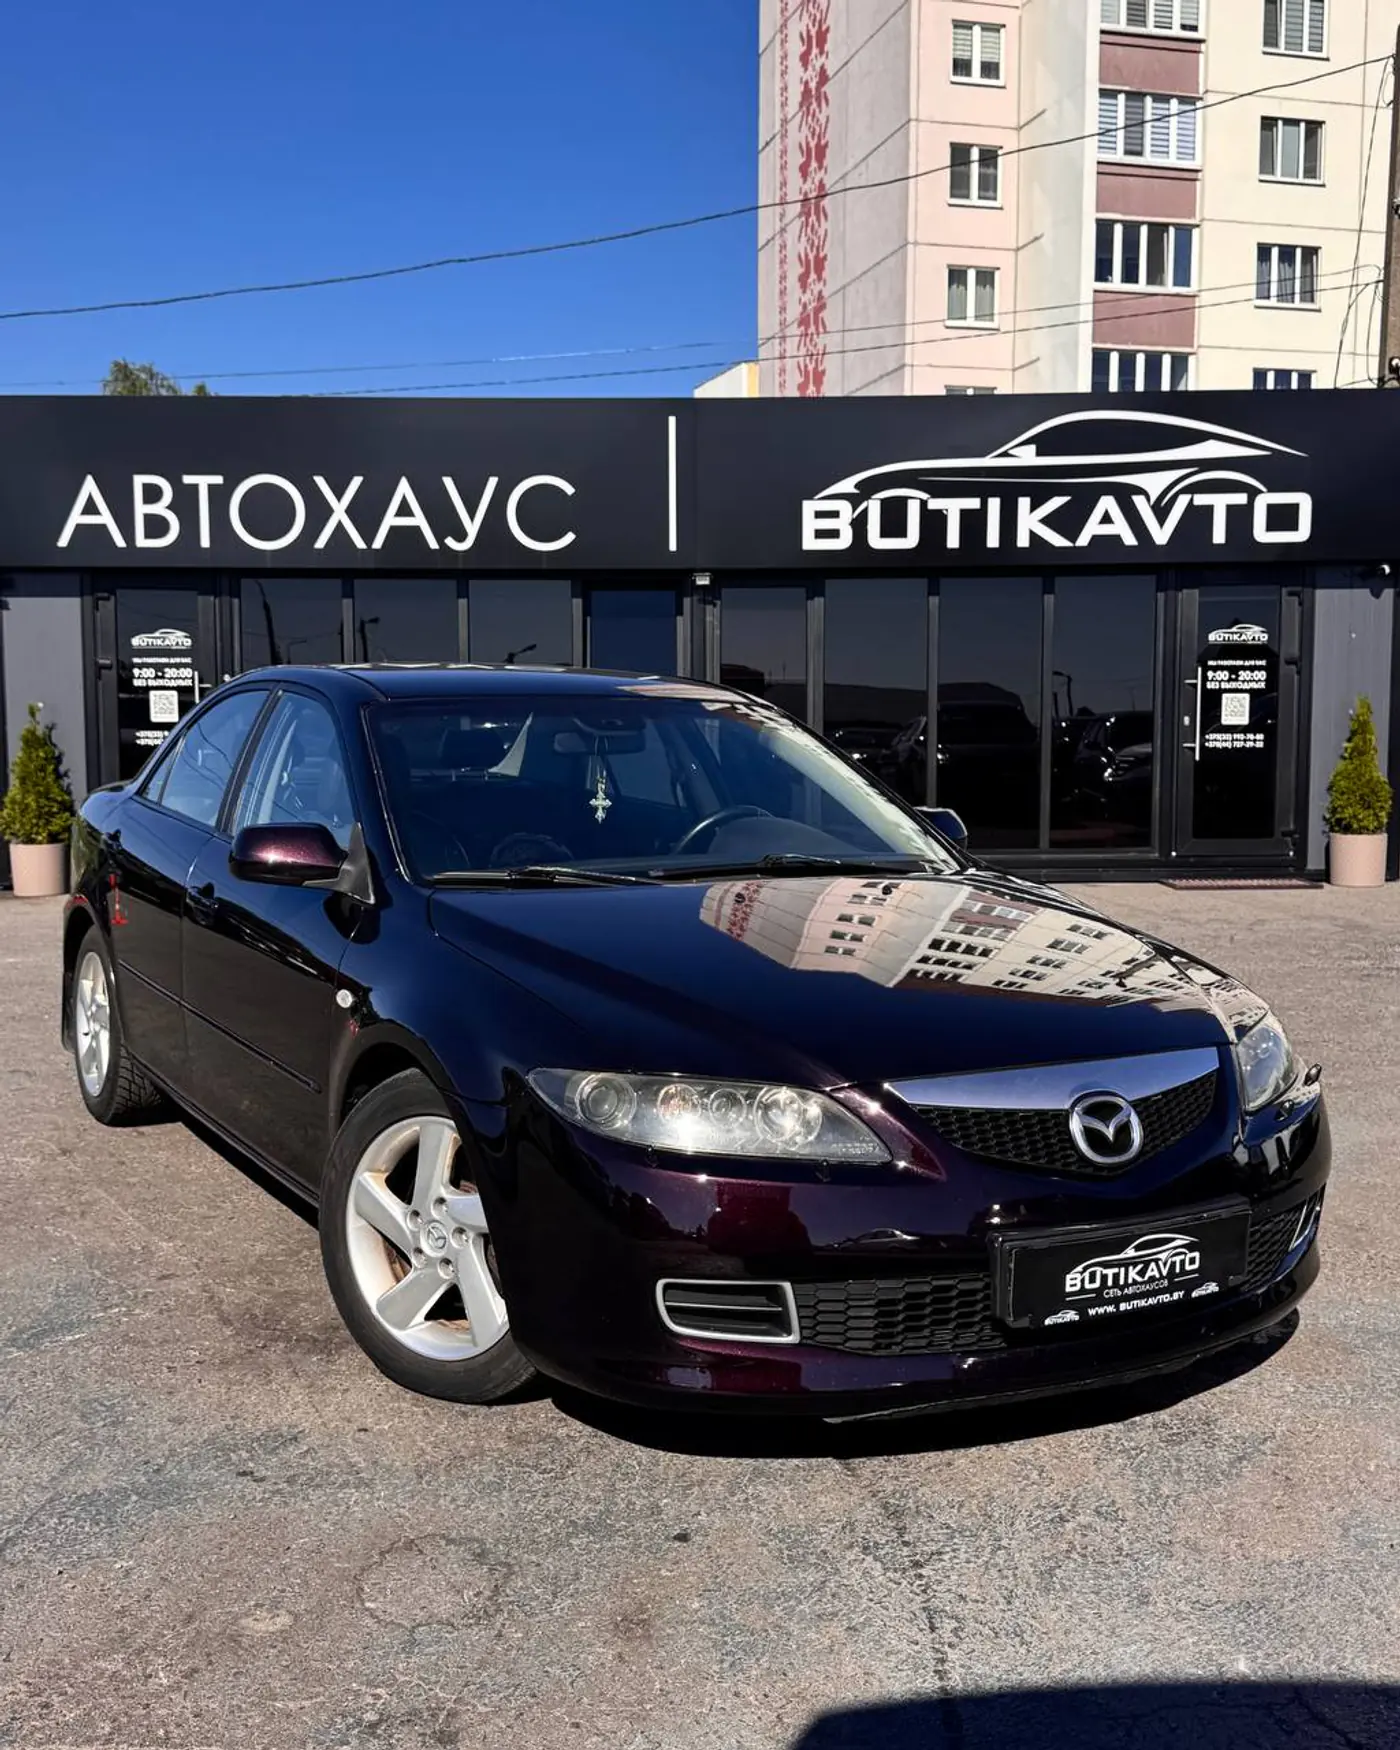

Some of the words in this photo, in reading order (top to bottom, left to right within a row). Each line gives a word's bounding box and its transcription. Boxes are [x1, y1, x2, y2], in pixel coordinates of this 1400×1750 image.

[56, 473, 576, 551] АВТОХАУС
[801, 491, 1312, 551] BUTIKAVTO
[132, 667, 156, 678] 9:00
[163, 667, 193, 678] 20:00
[1207, 670, 1229, 681] 9:00
[1237, 670, 1267, 681] 20:00
[1065, 1251, 1200, 1292] BUTIKAVTO
[1103, 1288, 1122, 1298] СЕТЬ
[1123, 1279, 1169, 1295] АВТОХАУСОВ
[1119, 1290, 1185, 1311] BUTIKAVTO.BY
